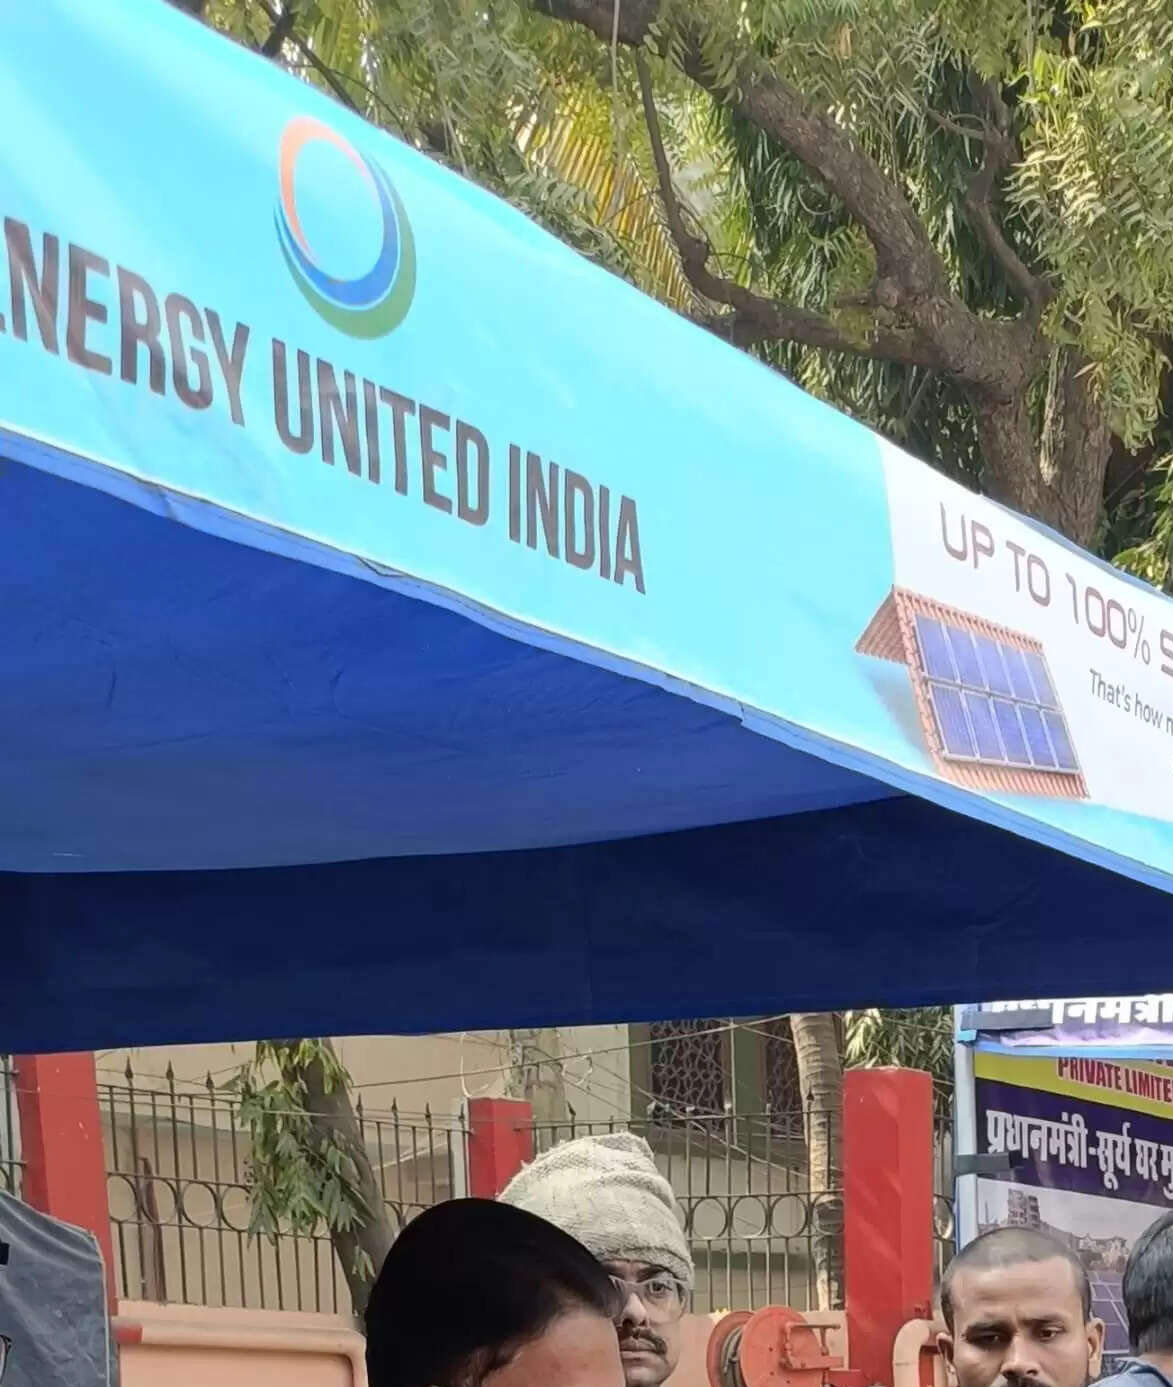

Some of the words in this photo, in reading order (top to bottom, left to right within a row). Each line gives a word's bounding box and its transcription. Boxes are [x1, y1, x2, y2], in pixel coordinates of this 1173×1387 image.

[0, 216, 250, 427] NERGY
[272, 337, 490, 527] UNITED
[507, 443, 646, 595] INDIA
[940, 502, 995, 570] UP
[1006, 541, 1051, 607] TO
[1066, 572, 1151, 665] 100%
[1089, 668, 1131, 713] That's
[1134, 697, 1163, 730] how
[1058, 1057, 1122, 1090] PRIVATE
[1134, 1138, 1160, 1182] घर
